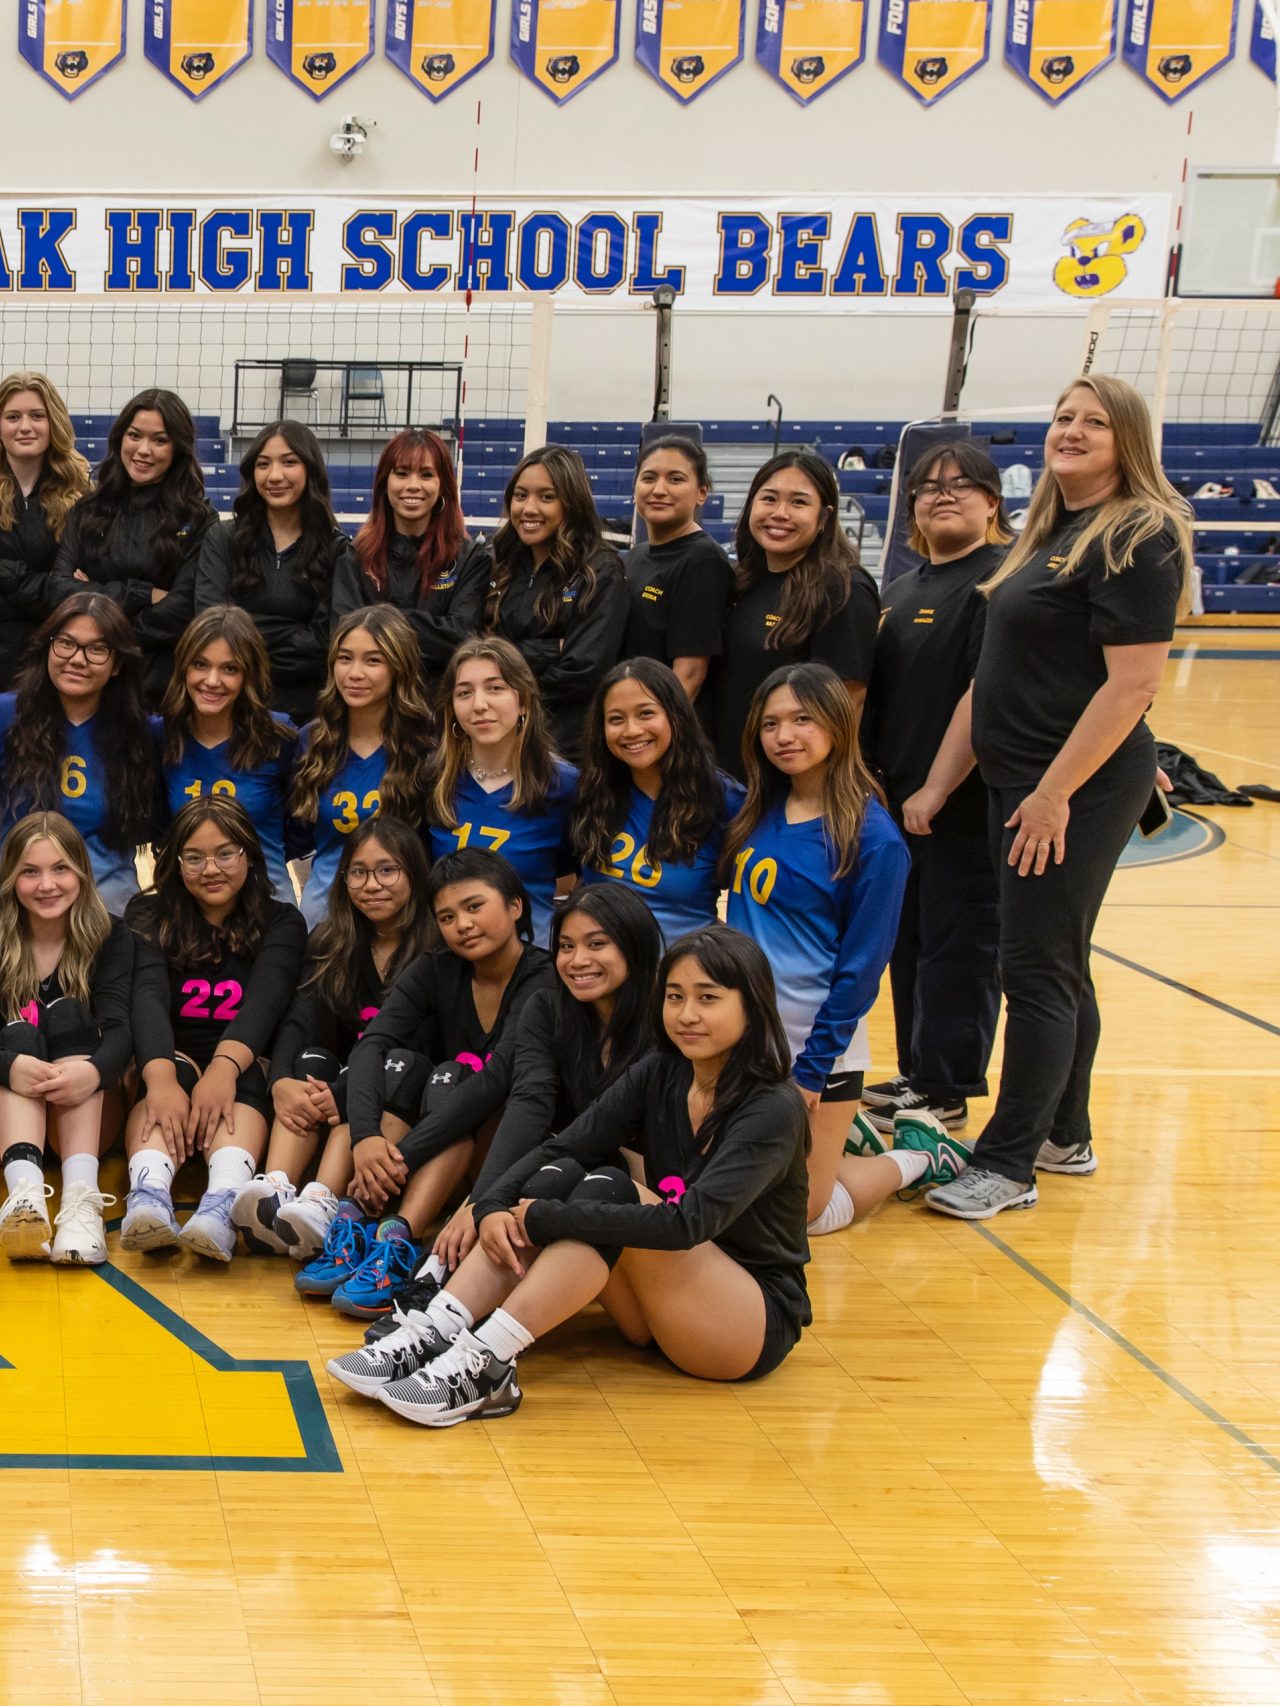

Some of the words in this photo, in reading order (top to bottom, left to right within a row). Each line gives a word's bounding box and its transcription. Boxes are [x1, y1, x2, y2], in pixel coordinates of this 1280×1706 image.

[27, 3, 38, 39] GIRLS
[153, 8, 164, 39] GIRLS
[275, 11, 285, 41] GIRLS
[394, 5, 407, 41] BOYS
[519, 5, 532, 42] GIRLS
[104, 208, 313, 293] HIGH
[340, 209, 686, 296] SCHOOL
[713, 211, 1012, 297] BEARS
[61, 755, 87, 798] 6
[452, 821, 511, 852] 17
[594, 831, 662, 888] 26
[733, 846, 778, 906] 10
[180, 979, 243, 1021] 22
